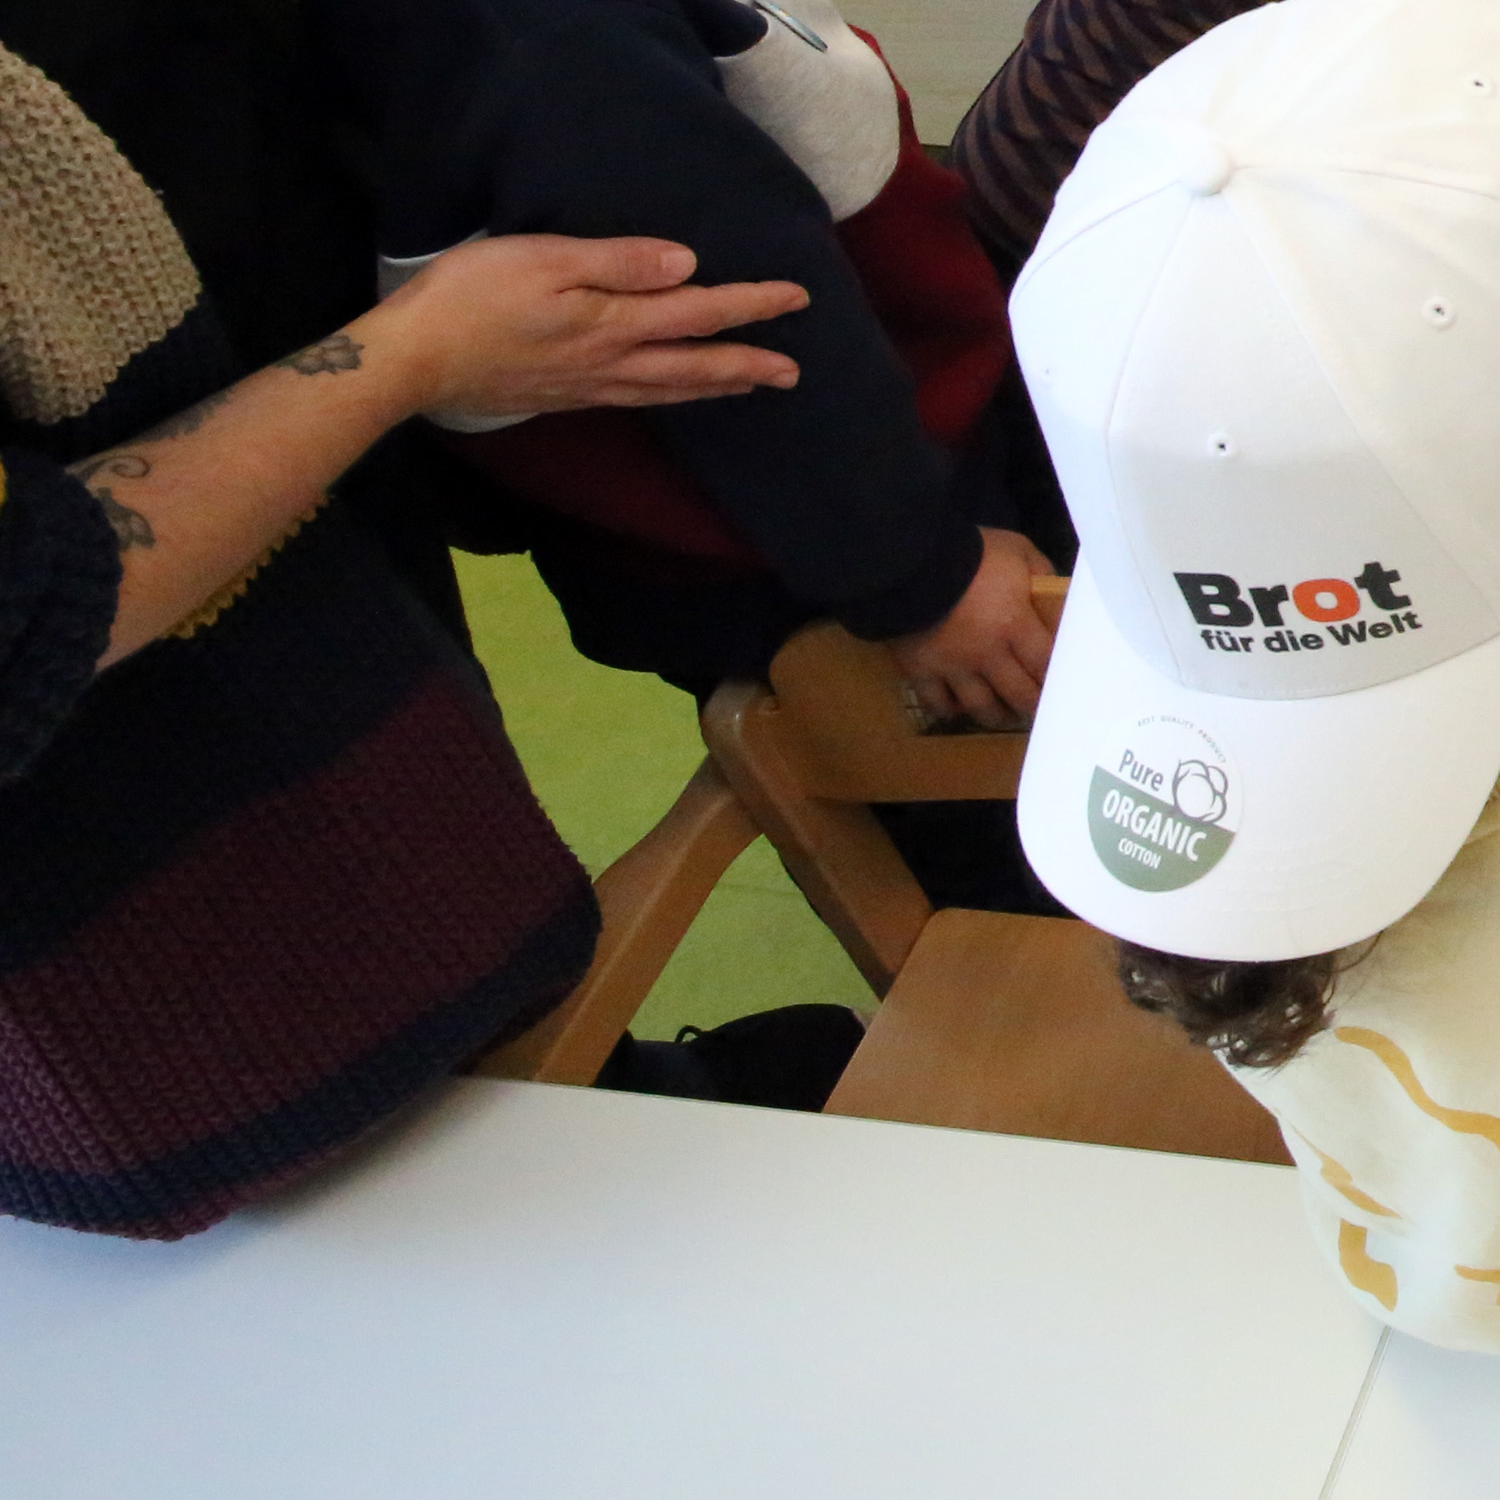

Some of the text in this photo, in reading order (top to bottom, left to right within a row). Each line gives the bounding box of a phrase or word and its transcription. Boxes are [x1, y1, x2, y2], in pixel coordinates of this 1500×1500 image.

[1173, 561, 1412, 627] Brot
[1201, 611, 1423, 653] für die Welt
[1119, 749, 1163, 791] Pure
[1102, 789, 1207, 861] ORGANIC
[1118, 838, 1162, 869] COTTON
